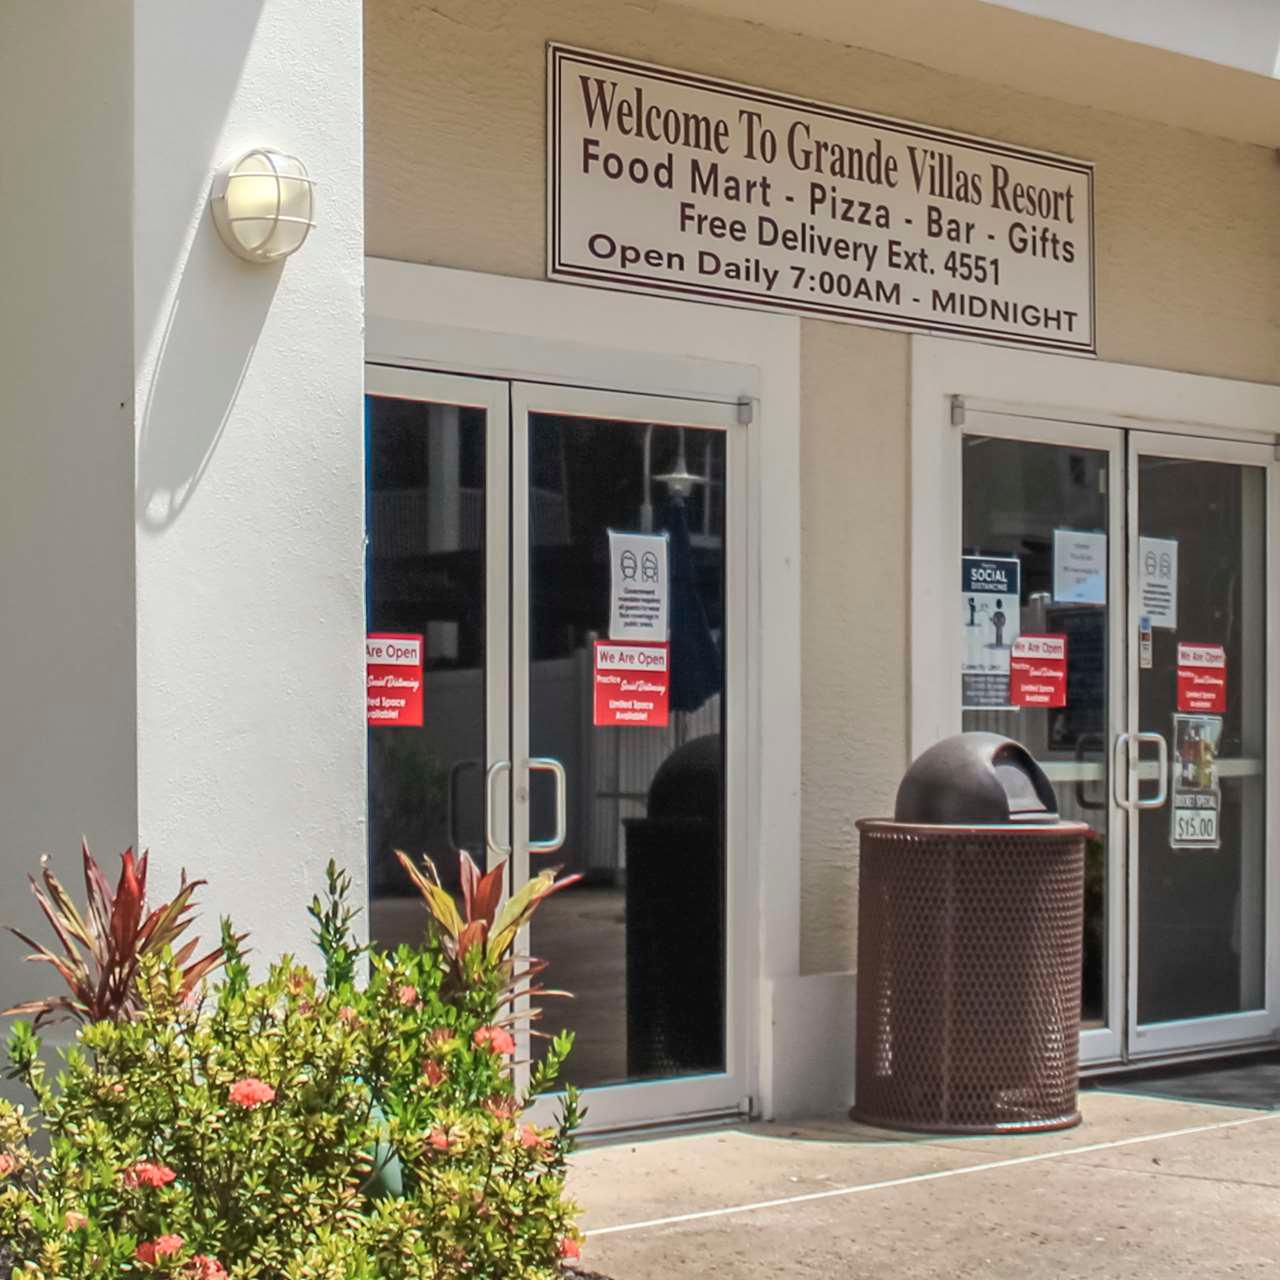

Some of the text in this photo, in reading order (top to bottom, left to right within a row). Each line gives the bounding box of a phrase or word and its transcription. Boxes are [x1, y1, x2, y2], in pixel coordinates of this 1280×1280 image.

[579, 75, 1074, 224] Welcome To Grande Villas Resort
[583, 138, 673, 189] Food
[691, 159, 771, 207] Mart
[810, 182, 890, 229] Pizza
[927, 205, 975, 244] Bar
[1009, 222, 1075, 263] Gifts
[680, 202, 1000, 286] Free Delivery Ext. 4551
[588, 233, 685, 272] Open
[698, 250, 779, 291] Daily
[790, 266, 901, 306] 7:00AM
[932, 289, 1078, 333] MIDNIGHT
[971, 568, 1008, 582] SOCIAL
[386, 645, 417, 660] Open
[600, 650, 665, 667] We Are Open
[1042, 642, 1063, 655] Open
[1178, 816, 1214, 838] $15.00
